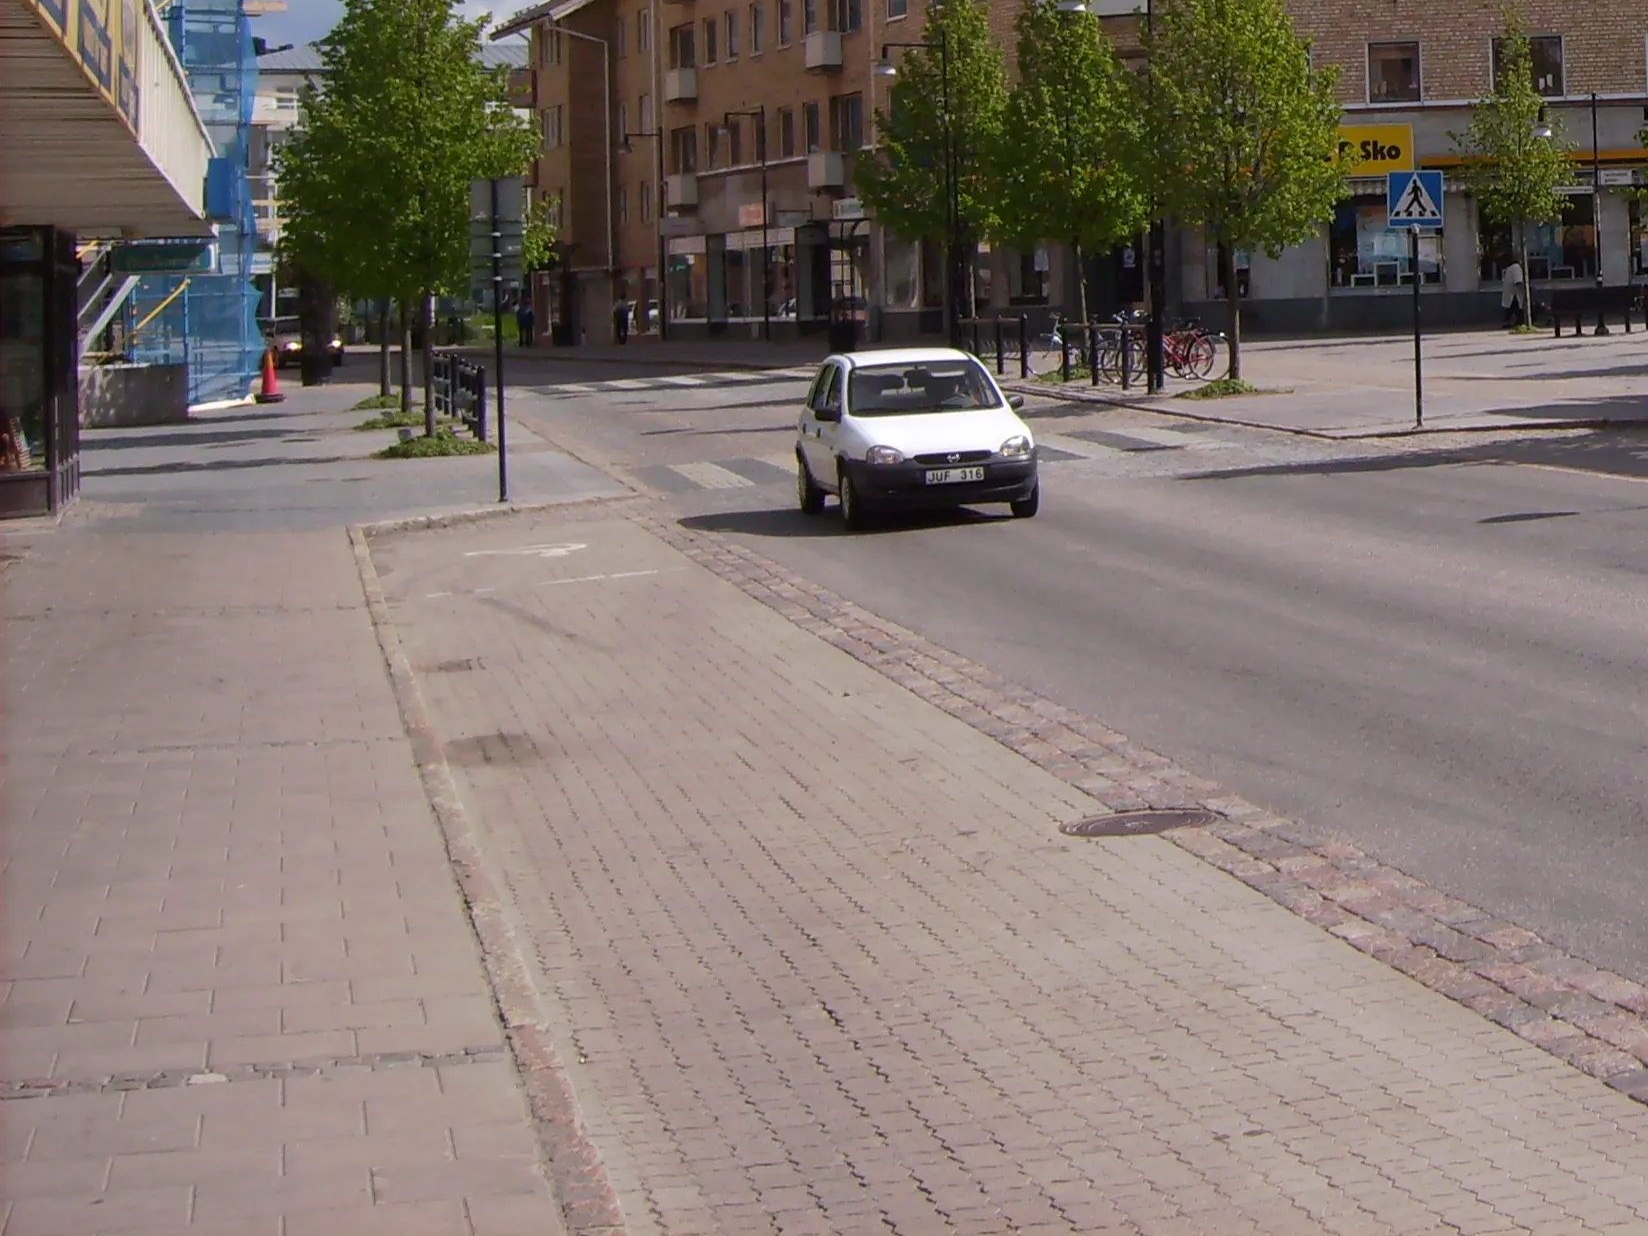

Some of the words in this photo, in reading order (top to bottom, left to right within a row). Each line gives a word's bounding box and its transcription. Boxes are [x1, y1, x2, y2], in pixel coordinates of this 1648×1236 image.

[1359, 140, 1401, 161] Sko
[927, 470, 951, 482] JUF
[960, 468, 983, 481] 316
